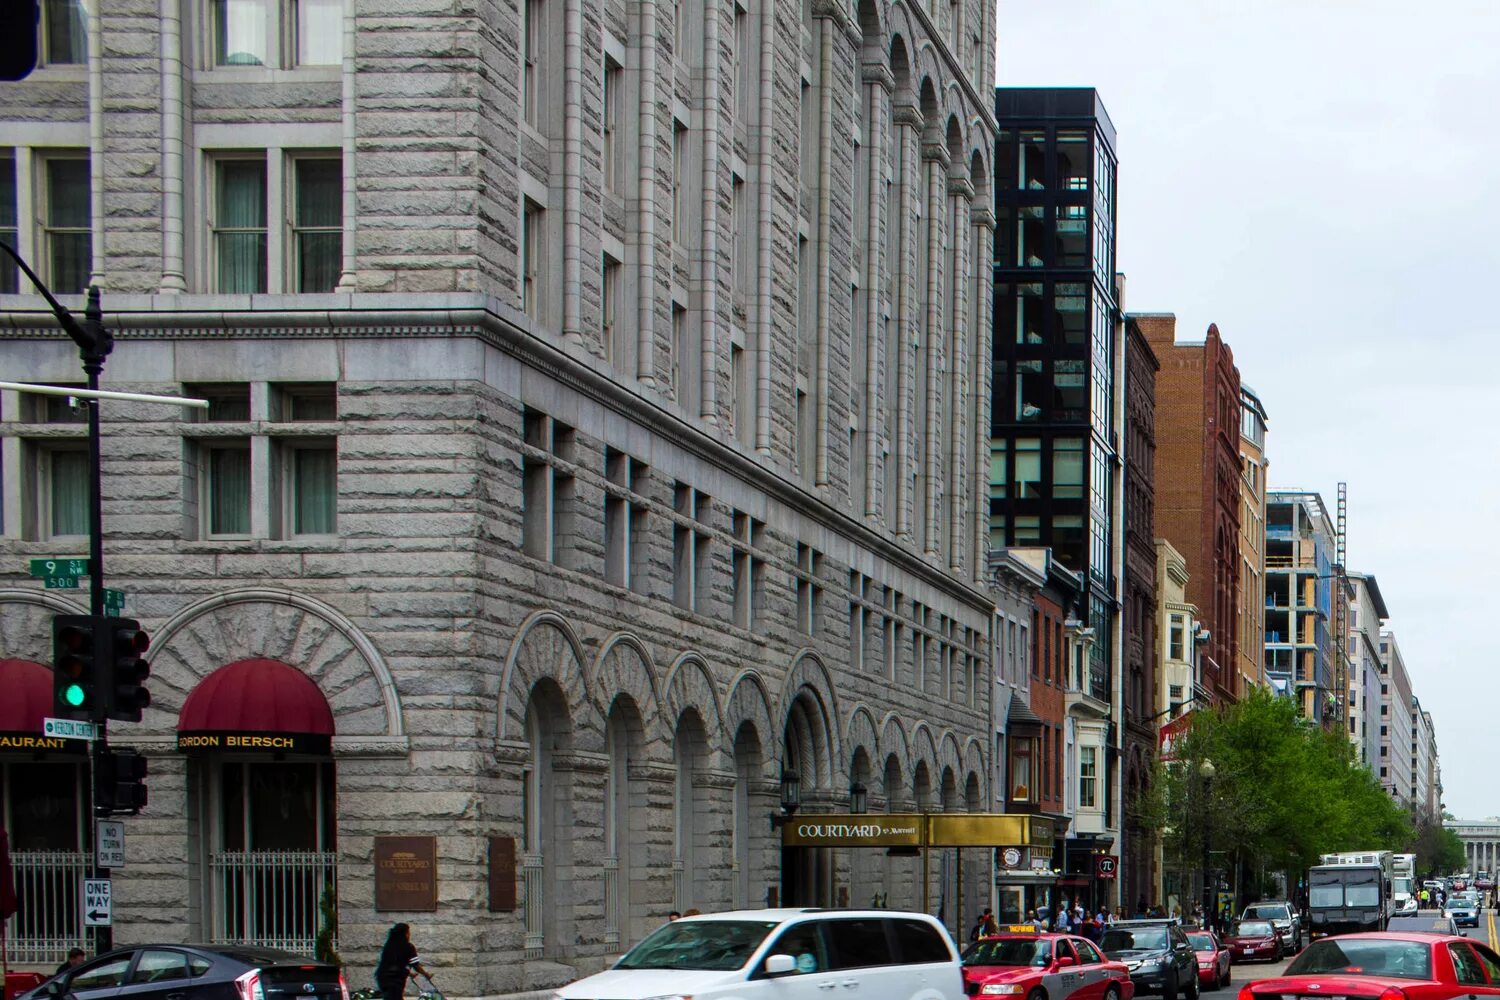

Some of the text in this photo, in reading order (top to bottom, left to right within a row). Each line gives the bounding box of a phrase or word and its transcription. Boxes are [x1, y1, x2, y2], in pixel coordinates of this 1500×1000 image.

[45, 560, 81, 575] 9 ST
[50, 577, 73, 587] 500
[0, 736, 66, 749] AURANT
[179, 736, 294, 748] GORDON BIERSCH
[105, 828, 117, 837] NO
[798, 824, 882, 838] COURTYARD
[102, 839, 120, 849] TURN
[87, 883, 109, 895] ONE
[86, 896, 110, 908] WAY
